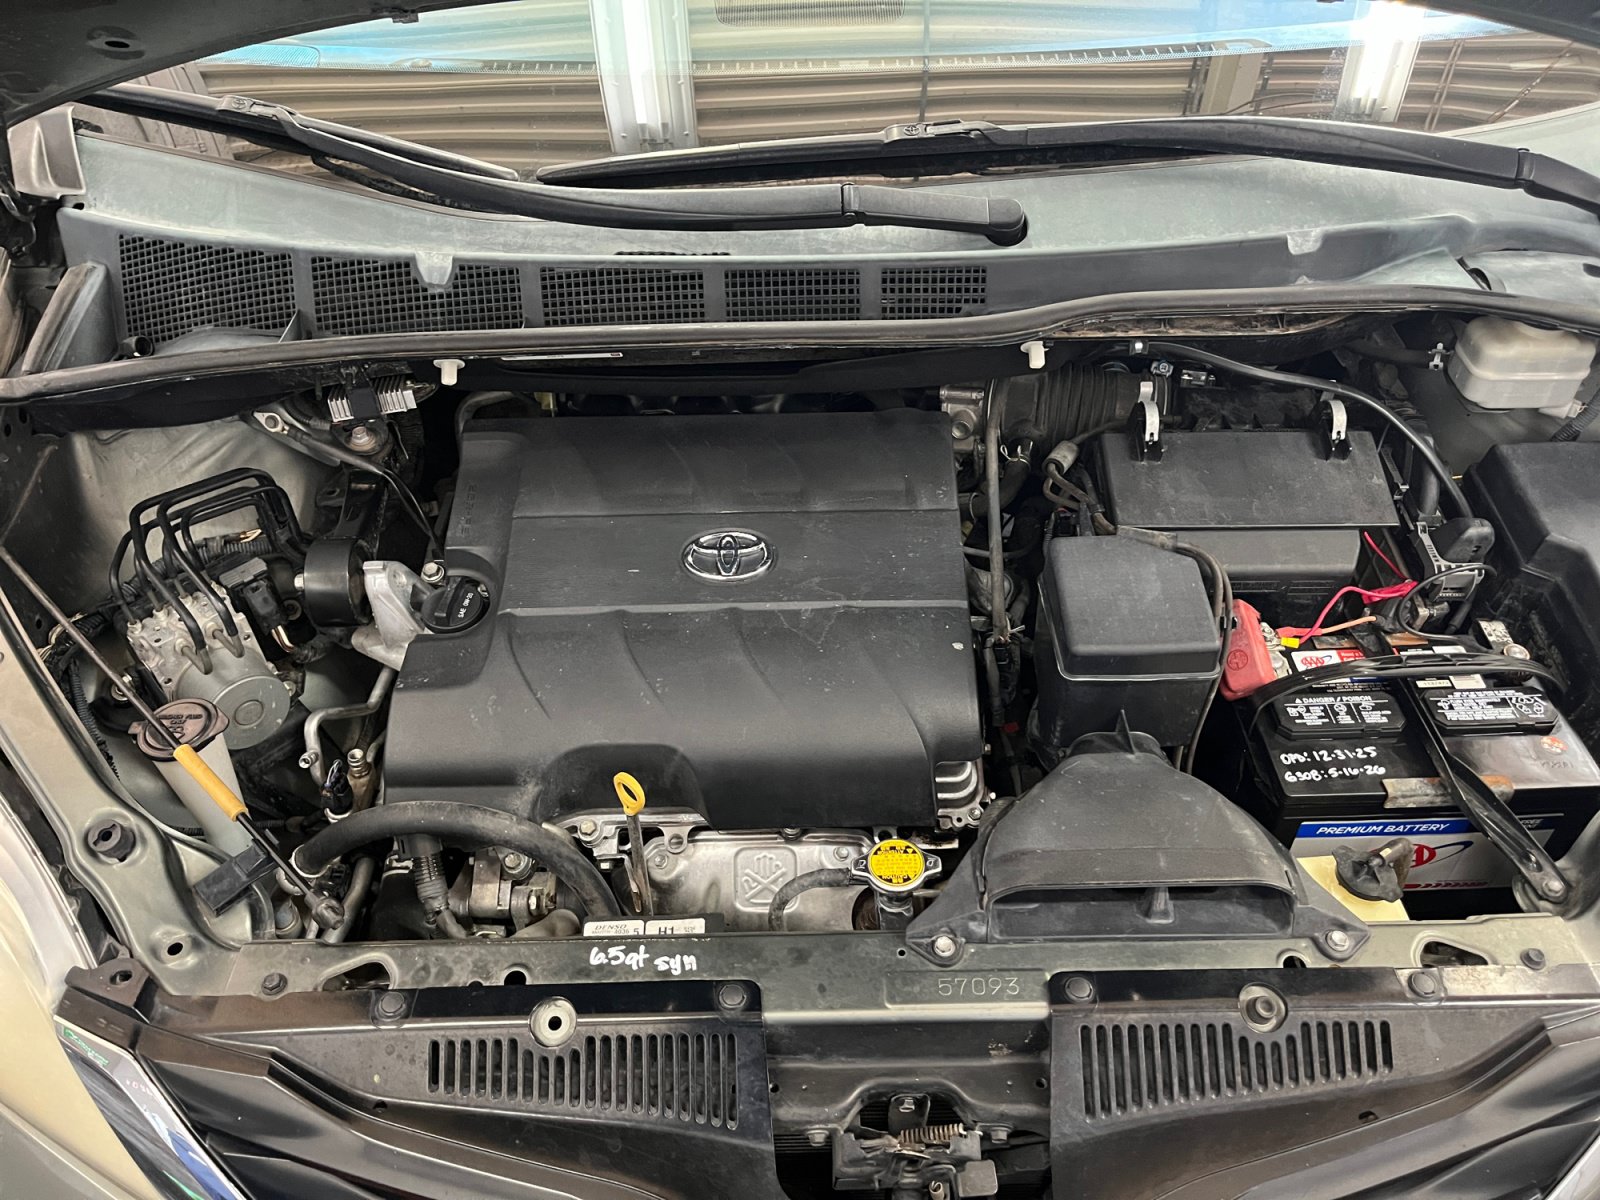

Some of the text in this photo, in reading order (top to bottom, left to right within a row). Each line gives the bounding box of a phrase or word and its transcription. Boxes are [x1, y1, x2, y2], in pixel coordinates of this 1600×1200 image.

[457, 592, 474, 618] SAE 0W-20
[1316, 823, 1450, 834] PREMIUM BATTERY
[653, 954, 697, 976] syn
[938, 977, 1020, 996] 57093
